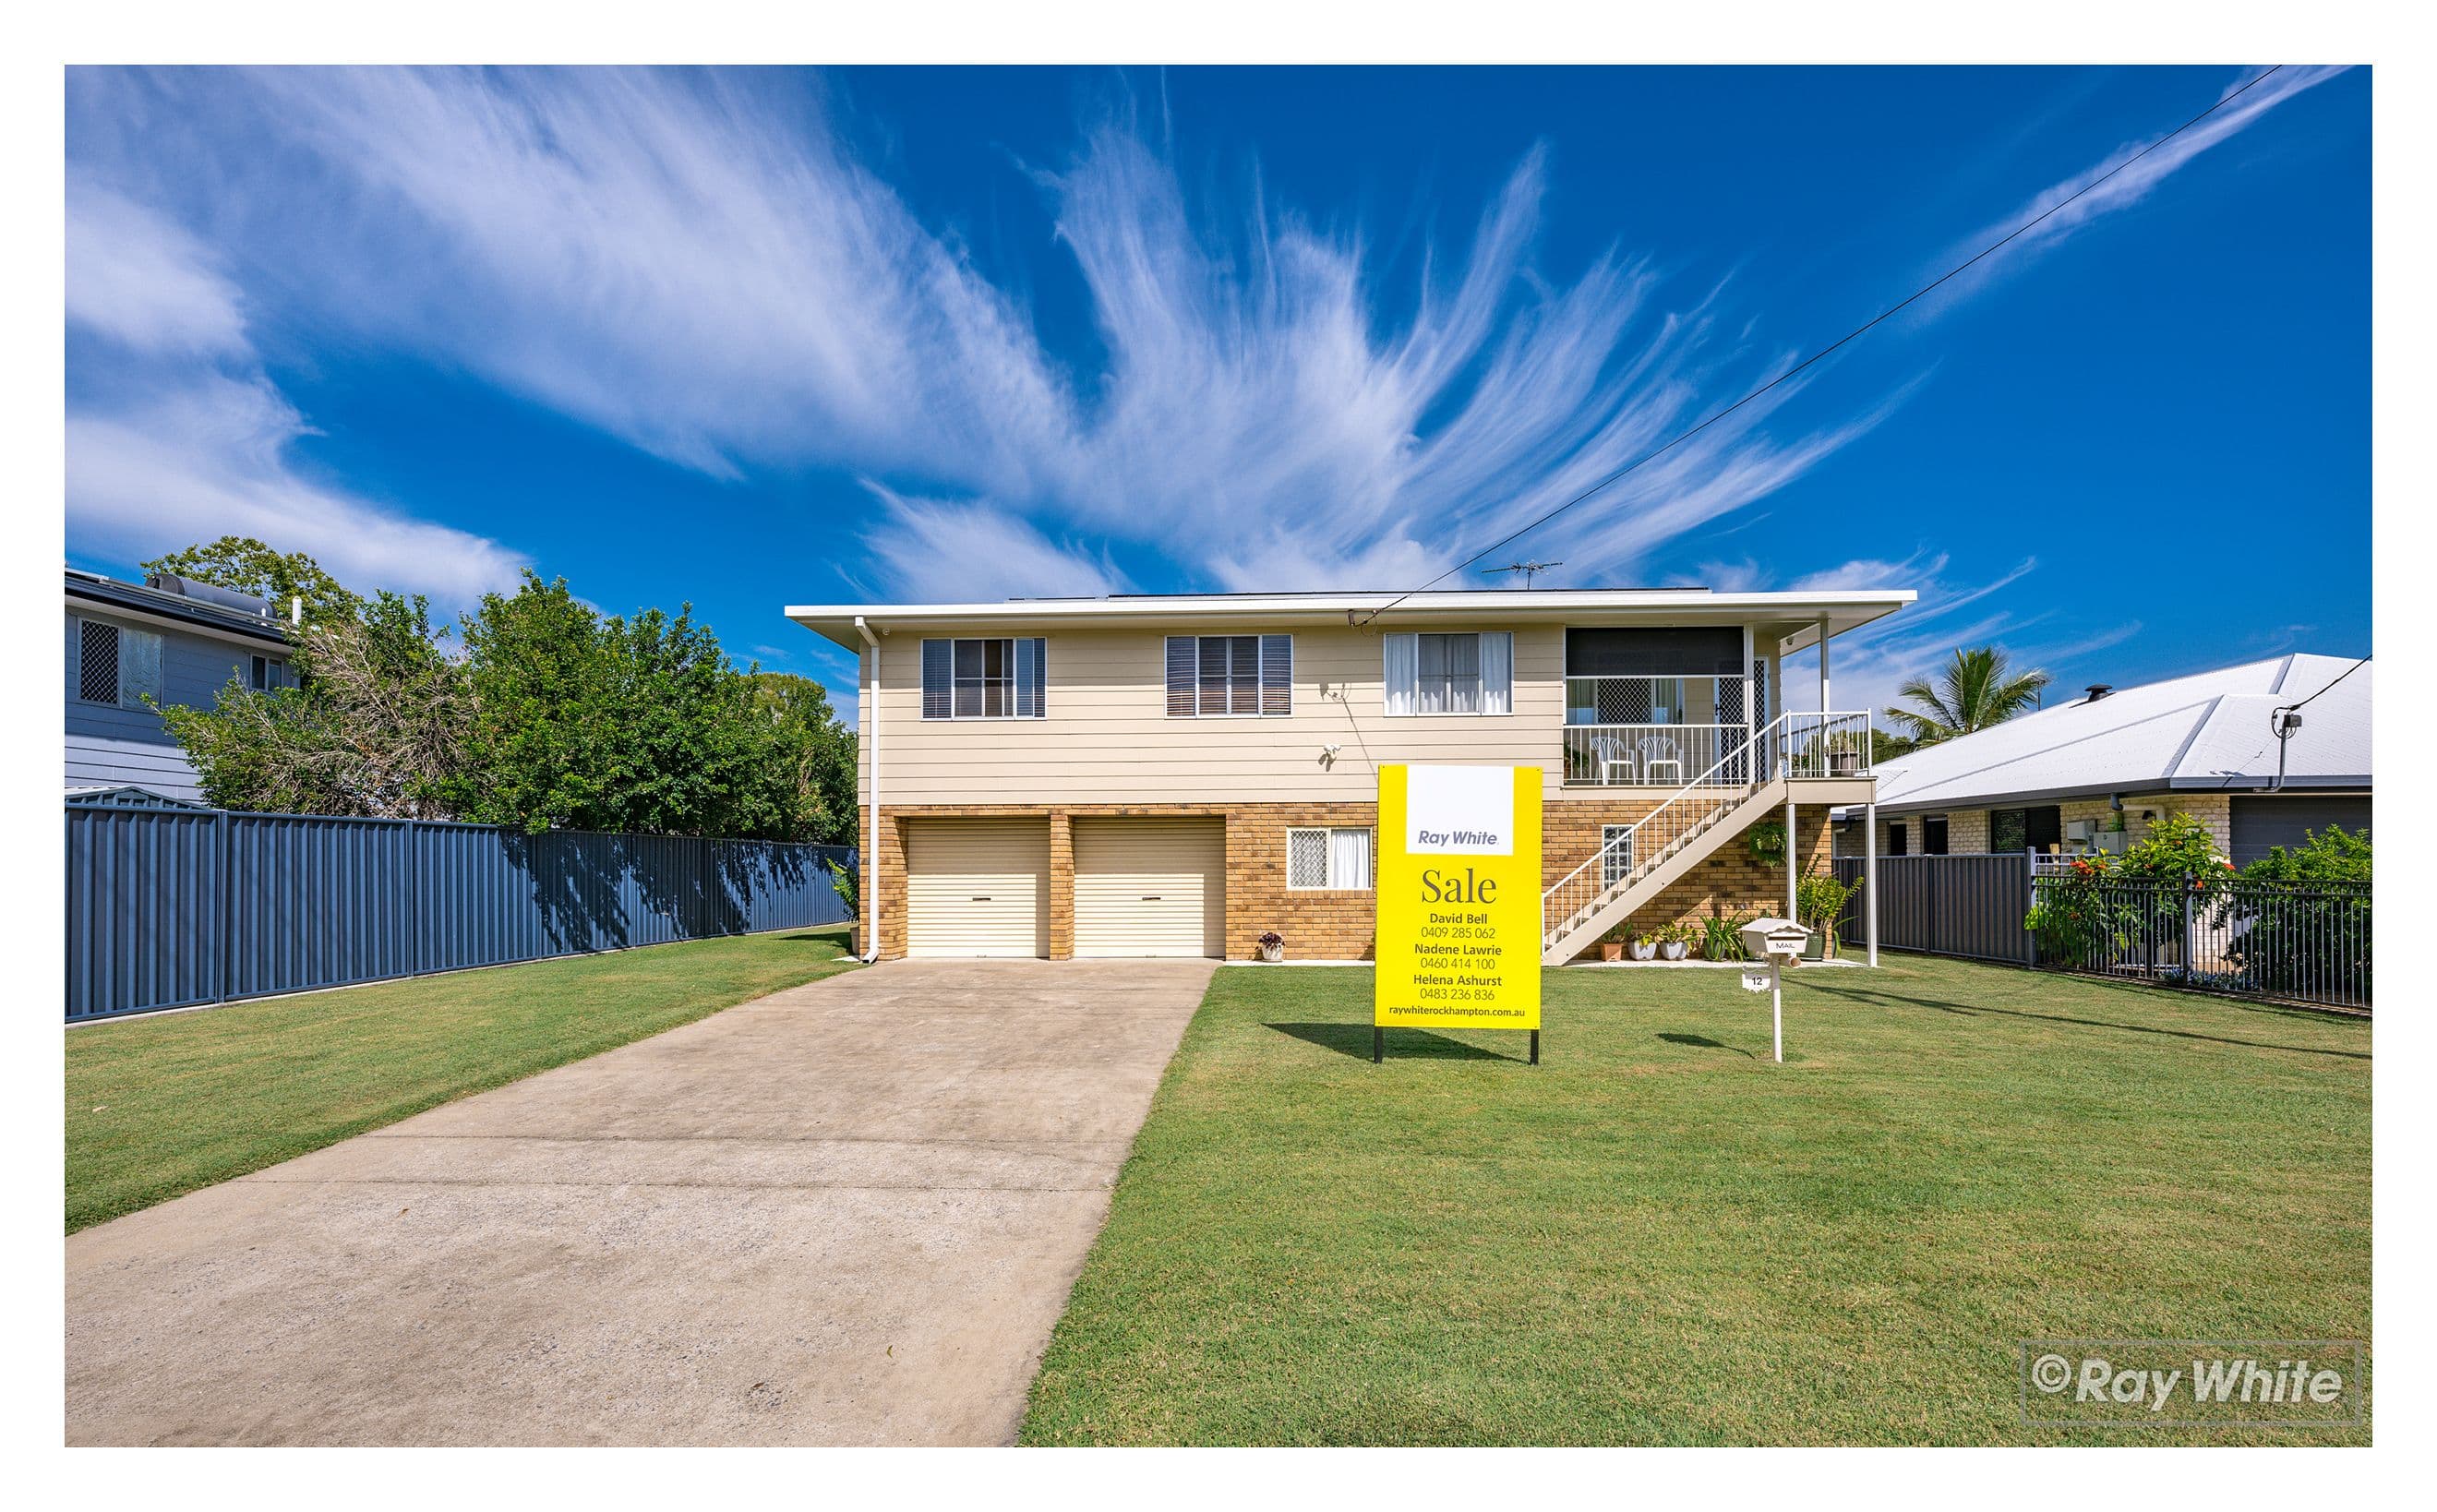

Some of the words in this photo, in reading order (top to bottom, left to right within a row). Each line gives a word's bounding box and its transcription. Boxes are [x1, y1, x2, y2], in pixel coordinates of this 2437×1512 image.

[1418, 831, 1448, 846] Ray
[1453, 831, 1497, 846] White
[1422, 869, 1496, 904] Sale
[1430, 914, 1462, 924] David
[1467, 914, 1487, 924] Bell
[1422, 928, 1448, 939] 0409
[1450, 928, 1472, 939] 285
[1475, 928, 1495, 939] 062
[1415, 943, 1459, 954] Nadene
[1463, 945, 1502, 955] Lawrie
[1421, 958, 1448, 969] 0460
[1451, 958, 1471, 969] 414
[1475, 958, 1495, 969] 100
[1413, 975, 1453, 985] Helena
[1457, 976, 1502, 986] Ashurst
[1752, 977, 1762, 985] 12
[1420, 989, 1447, 1000] 0483
[1450, 989, 1471, 1000] 236
[1474, 990, 1495, 1001] 836
[1389, 1005, 1525, 1018] raywhiterockhampton.com.au
